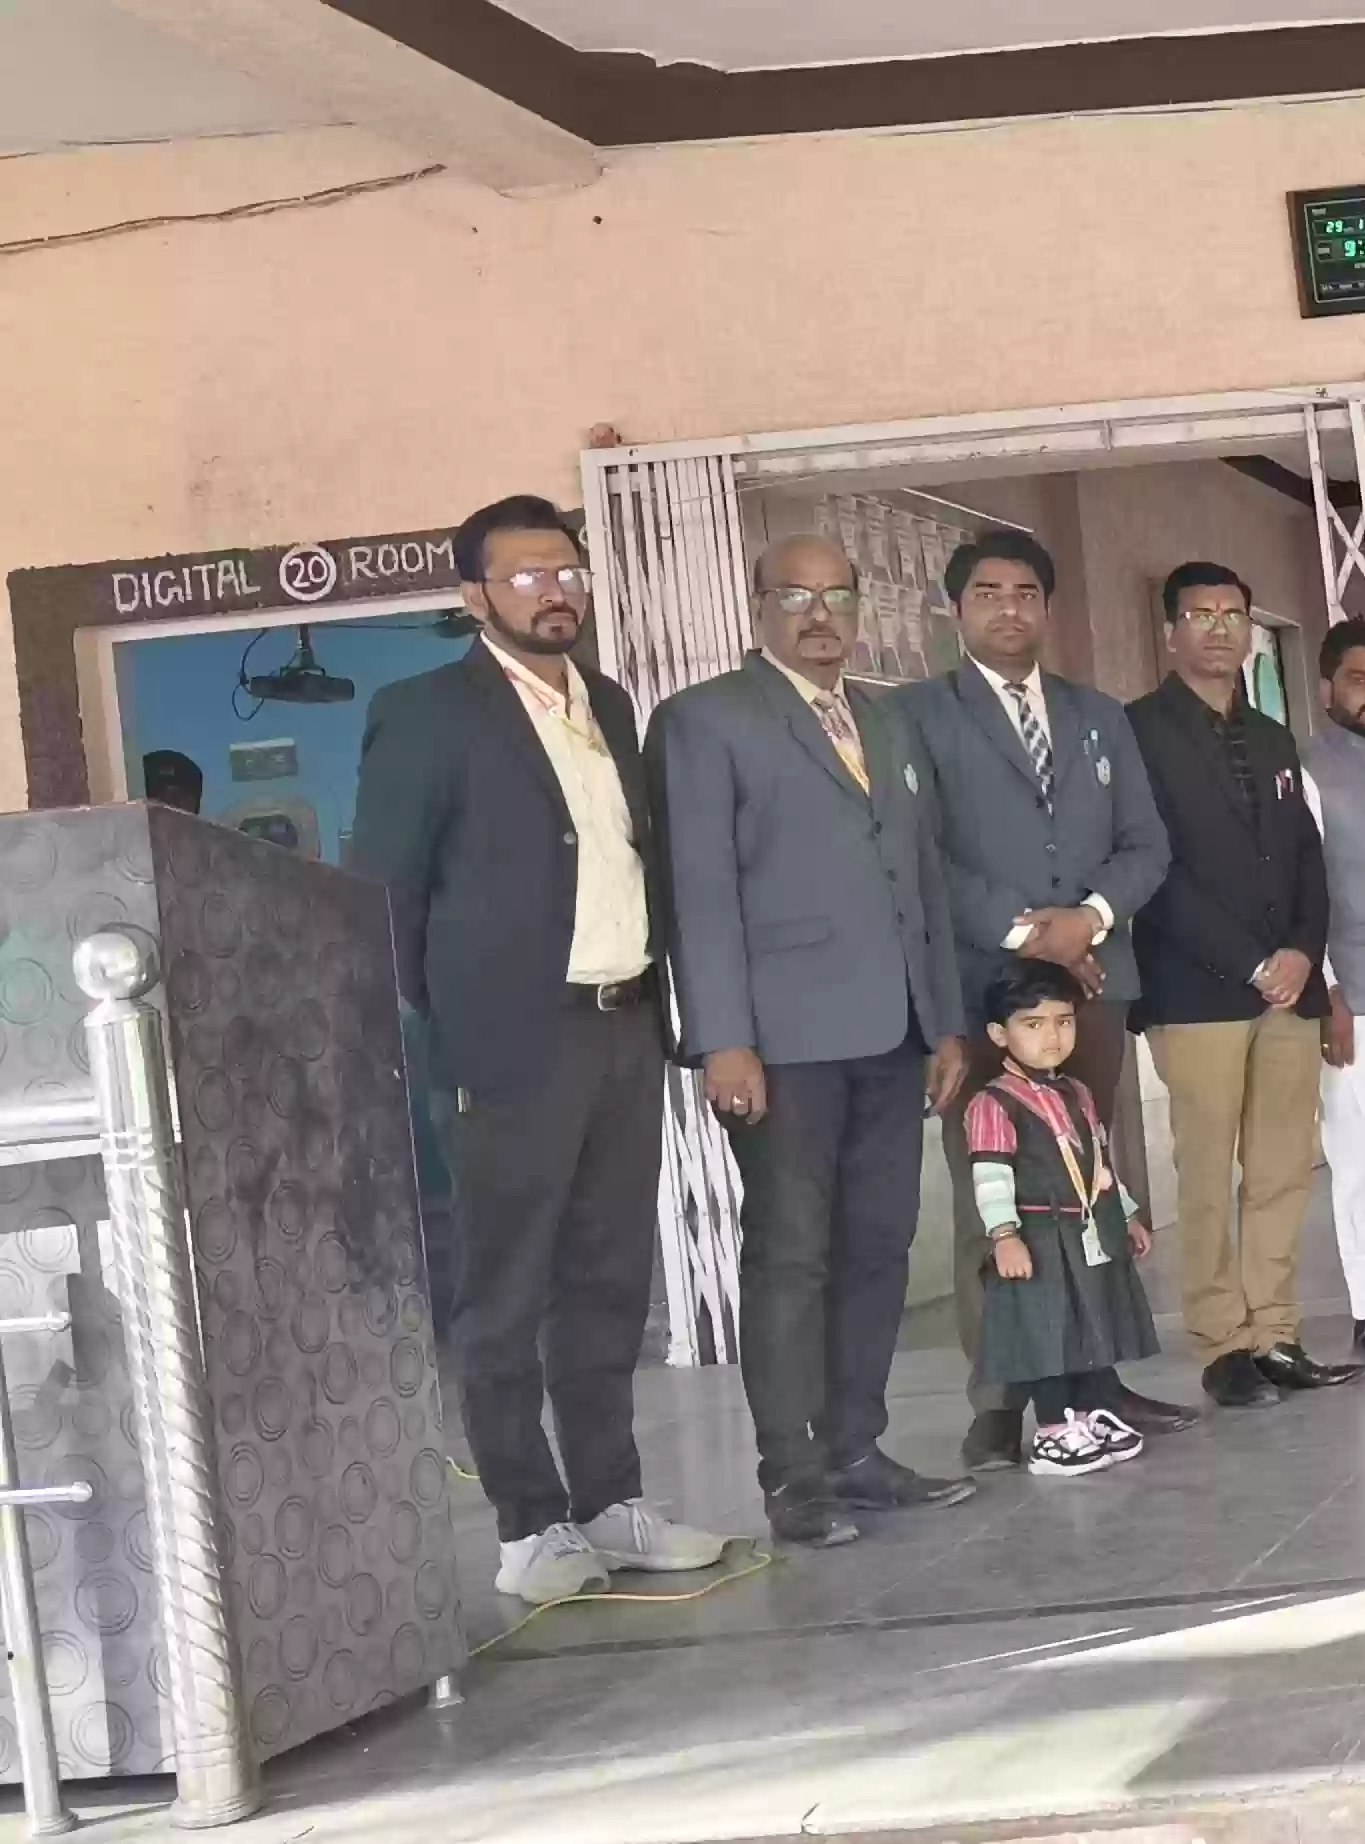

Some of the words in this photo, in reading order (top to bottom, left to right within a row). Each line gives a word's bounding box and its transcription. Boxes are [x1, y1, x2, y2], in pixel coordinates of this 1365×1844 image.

[112, 559, 261, 614] DIGITAL
[286, 555, 329, 589] 20
[348, 537, 456, 581] ROOM
